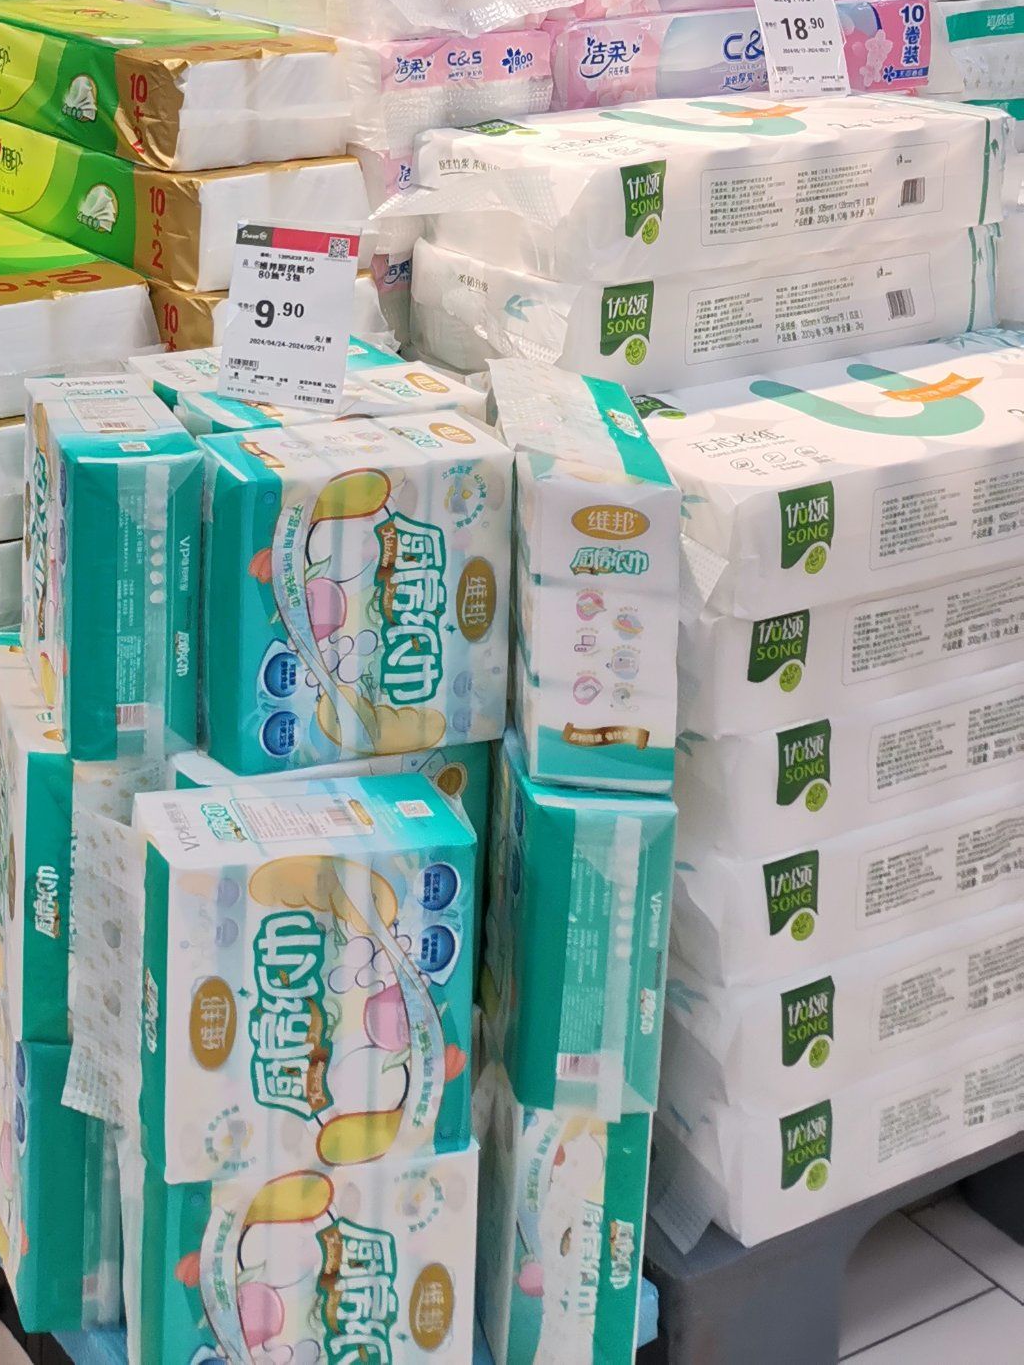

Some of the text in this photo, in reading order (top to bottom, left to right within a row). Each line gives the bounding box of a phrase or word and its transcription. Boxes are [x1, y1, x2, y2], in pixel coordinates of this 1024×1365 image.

[780, 16, 825, 41] 18.90
[901, 3, 925, 24] 10
[447, 50, 482, 67] C&S
[510, 52, 533, 66] 1800
[584, 39, 632, 70] 洁柔
[722, 30, 766, 64] C&
[130, 72, 148, 104] 10
[626, 171, 661, 201] 优颂
[630, 195, 661, 217] SONG
[149, 186, 166, 270] 10 2
[163, 303, 179, 335] 10
[254, 299, 305, 329] 9.90
[607, 293, 649, 320] 优颂
[607, 317, 646, 335] SONG
[587, 510, 637, 534] 维邦
[785, 496, 829, 527] 优颂
[787, 523, 829, 546] SONG
[381, 517, 446, 704] 厨房纸巾
[464, 573, 489, 632] 维邦
[758, 614, 804, 644] 优颂
[756, 640, 802, 661] SONG
[784, 734, 825, 767] 优颂
[785, 760, 825, 784] SONG
[770, 864, 813, 898] 优颂
[770, 889, 812, 914] SONG
[252, 912, 327, 1118] 厨房纸巾
[788, 991, 829, 1027] 优颂
[788, 1017, 829, 1043] SONG
[787, 1115, 826, 1151] 优颂
[786, 1140, 826, 1166] SONG
[334, 1219, 396, 1365] 厨房纸
